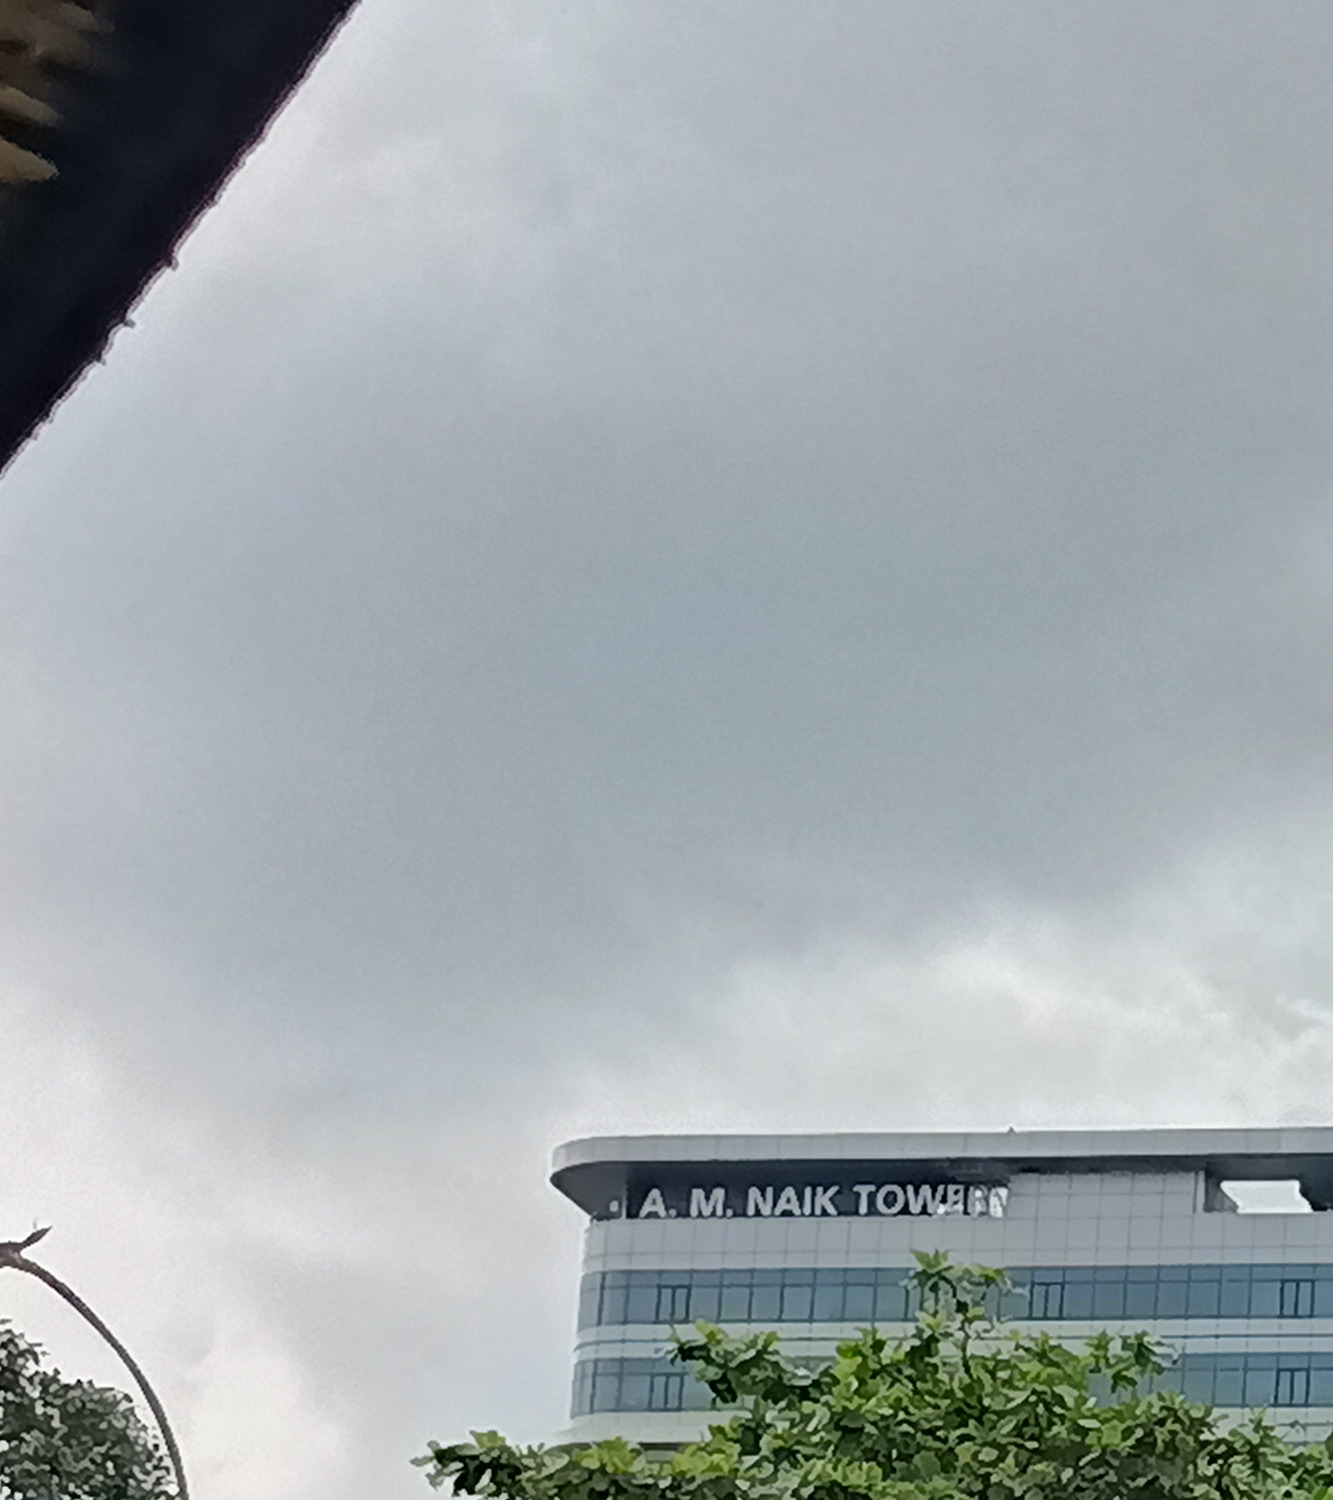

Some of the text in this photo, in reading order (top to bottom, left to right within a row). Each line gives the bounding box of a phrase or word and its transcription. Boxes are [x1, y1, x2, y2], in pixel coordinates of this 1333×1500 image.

[638, 1187, 677, 1218] A.
[689, 1187, 733, 1218] M.
[746, 1186, 839, 1217] NAIK
